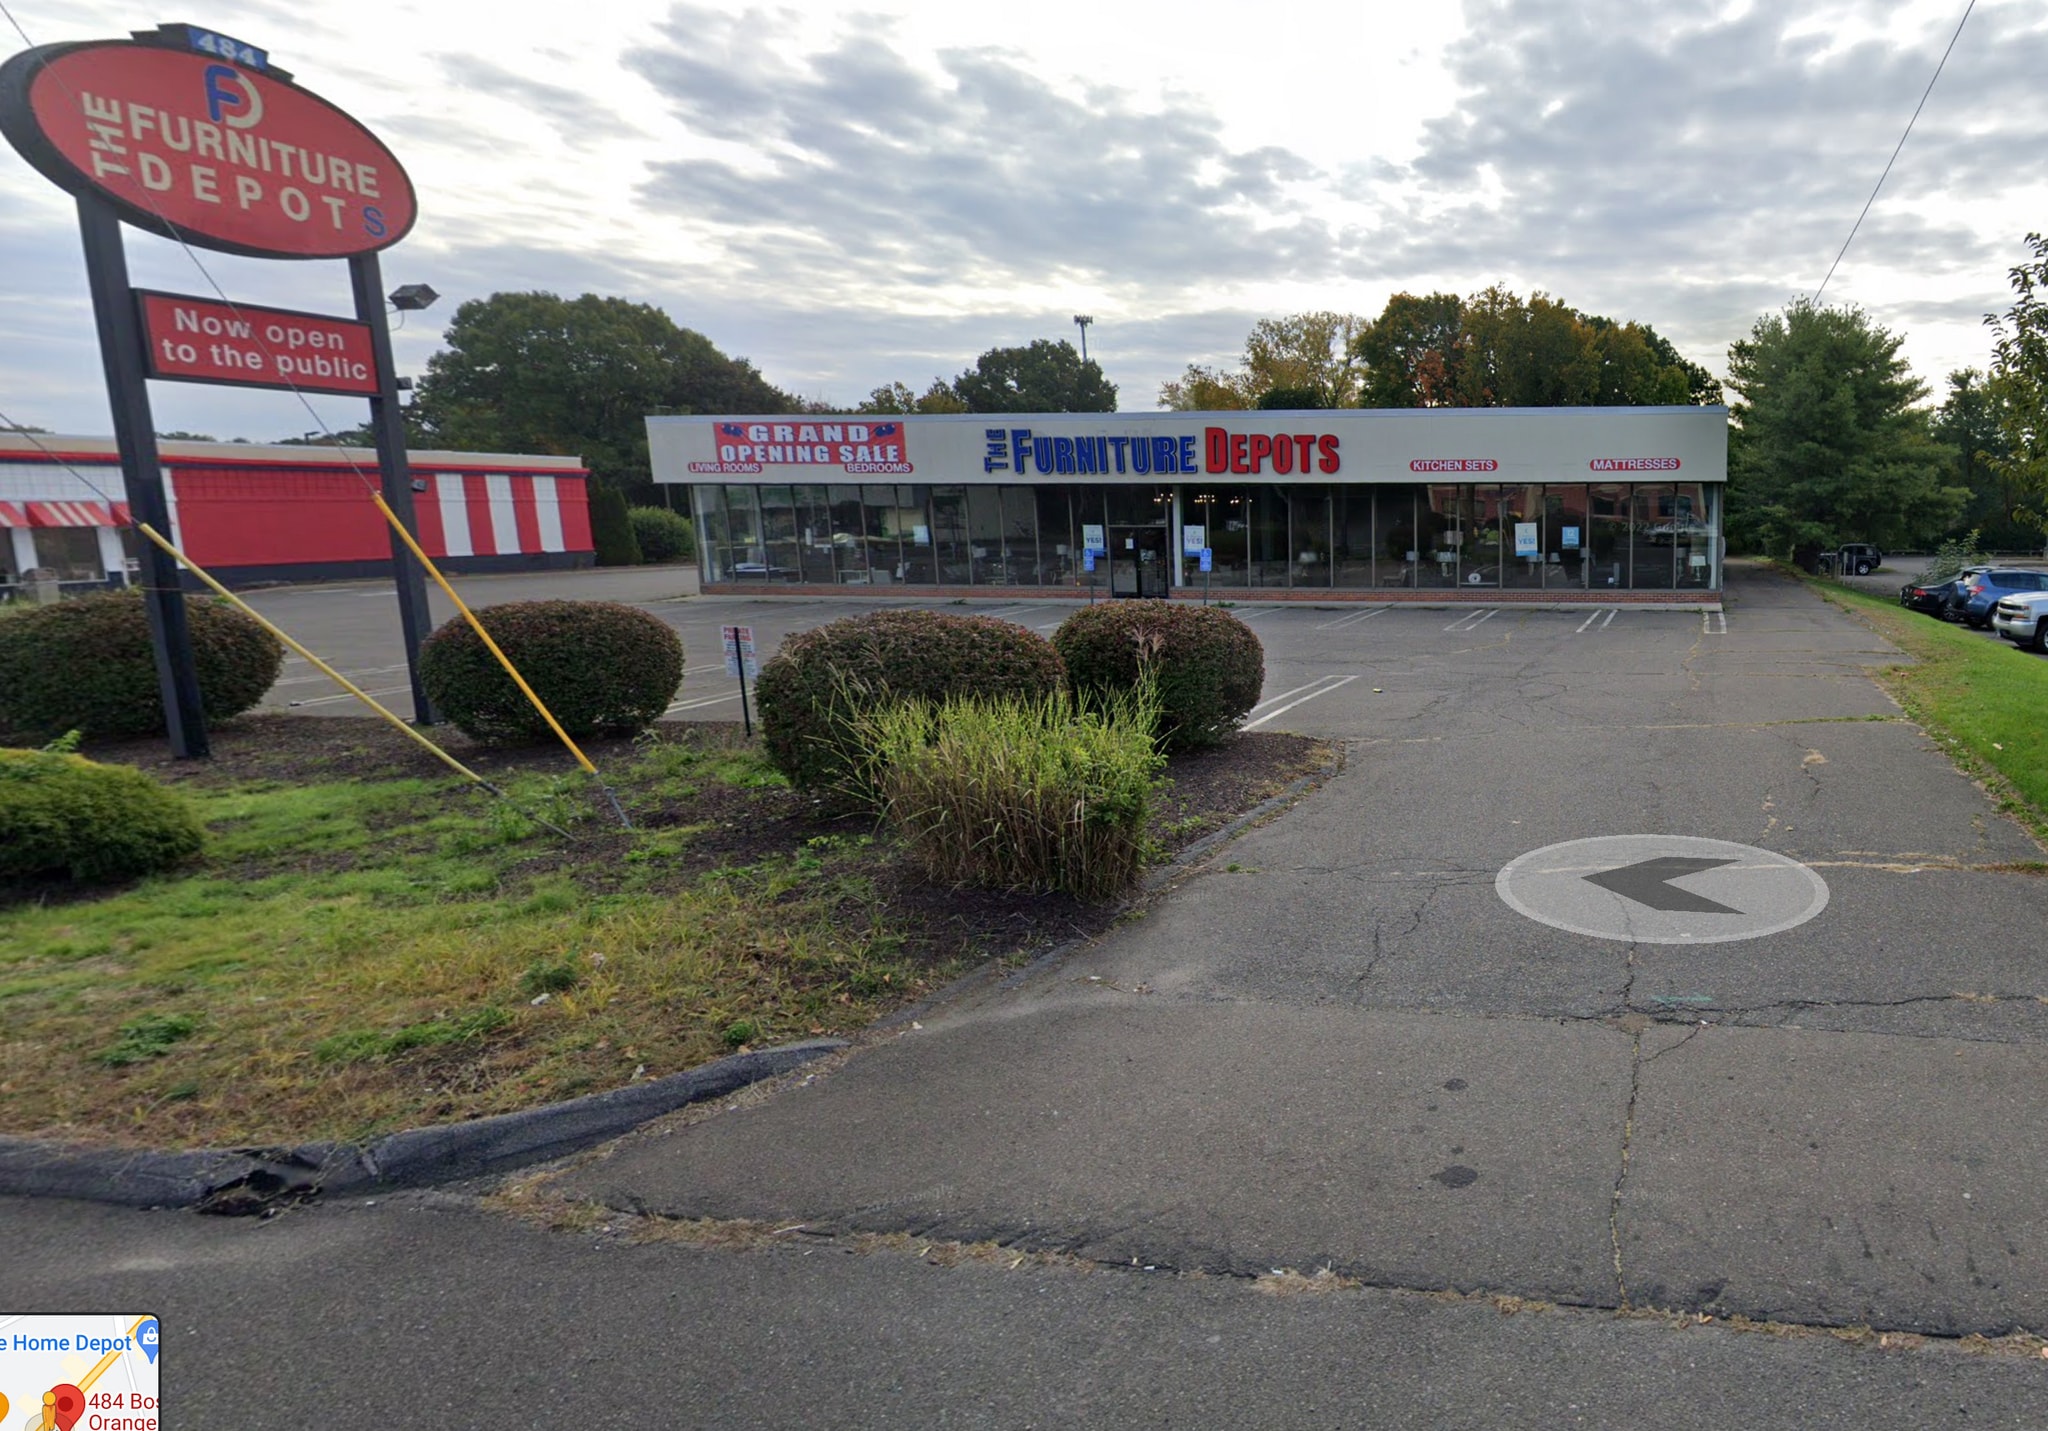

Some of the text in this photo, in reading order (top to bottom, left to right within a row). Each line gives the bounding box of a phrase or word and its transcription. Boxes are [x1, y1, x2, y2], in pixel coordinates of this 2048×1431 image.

[198, 33, 256, 65] 484
[82, 91, 130, 178] THE
[128, 103, 381, 199] FURNITURE
[174, 308, 344, 352] Now open
[162, 339, 367, 381] to the public
[748, 424, 869, 443] GRAND
[721, 445, 899, 463] OPENING SALE
[984, 428, 1008, 473] THE
[1011, 427, 1340, 475] FURNITURE DEPOTS
[1413, 459, 1494, 471] KITCHEN SETS
[1593, 458, 1678, 470] MATTRESSES
[689, 463, 761, 473] LIVING ROOMS
[846, 463, 910, 473] BEDROOMS
